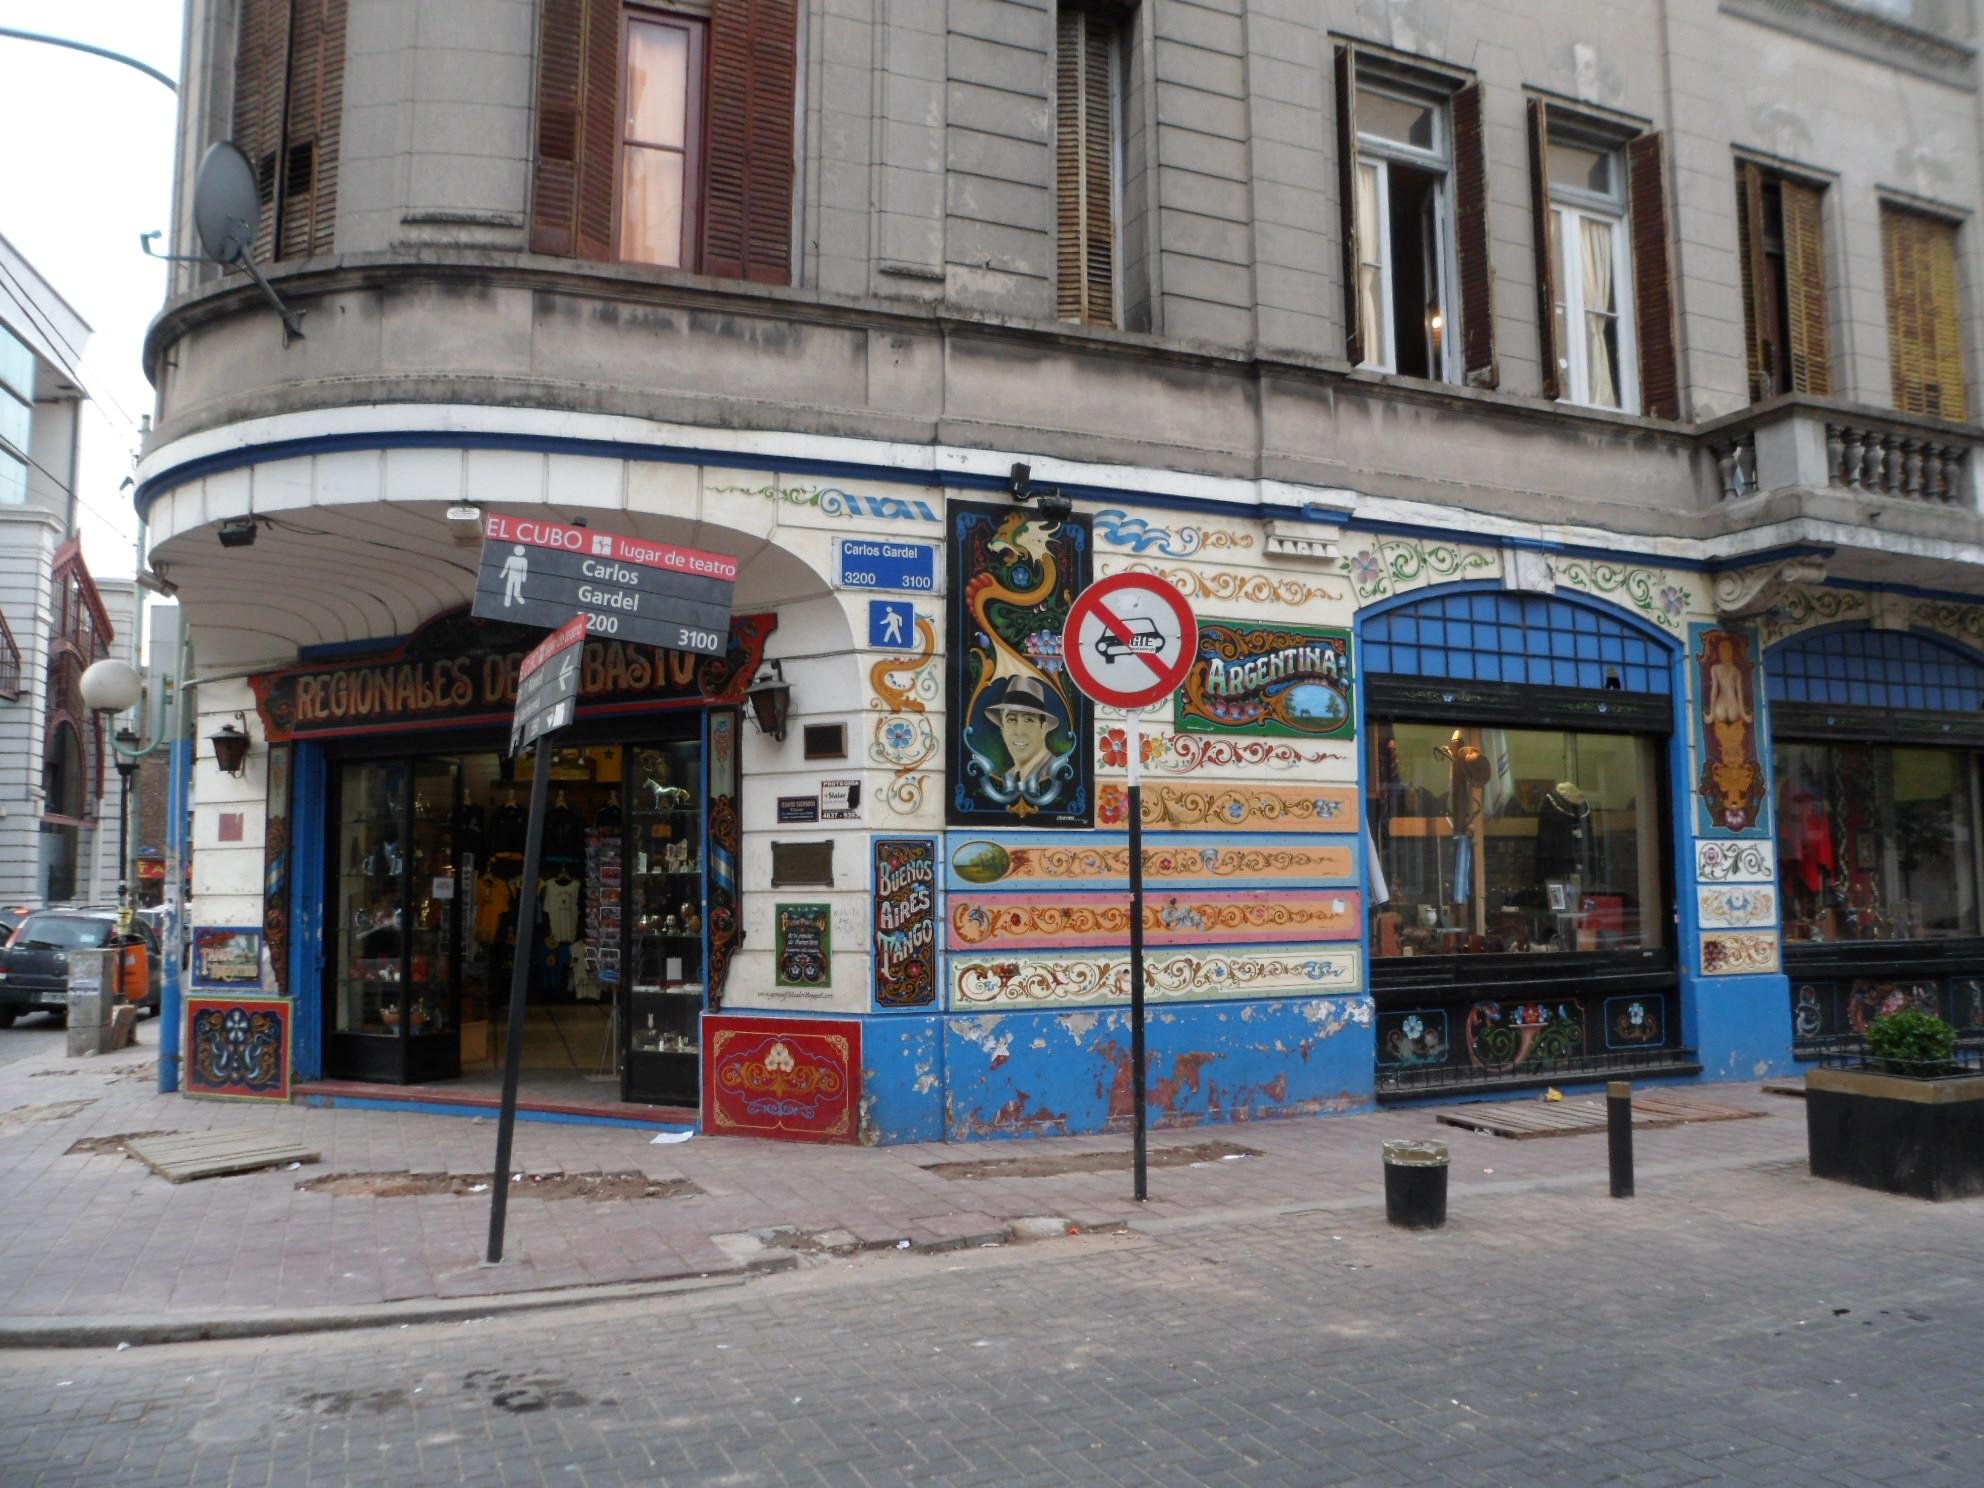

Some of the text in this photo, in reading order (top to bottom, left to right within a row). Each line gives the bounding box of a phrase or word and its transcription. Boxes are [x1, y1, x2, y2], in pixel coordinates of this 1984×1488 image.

[486, 518, 736, 577] EL CUBO lugar de teatro
[843, 542, 918, 559] Carlos Gardel
[582, 560, 639, 585] Carlos
[844, 571, 931, 589] 3200 3100
[578, 585, 639, 612] Gardel
[577, 611, 718, 650] 200 3100
[297, 658, 474, 719] REGIONALES
[1206, 647, 1338, 696] ARGENTINA
[880, 860, 933, 897] BUENOS
[880, 890, 930, 929] AIRES
[877, 919, 934, 981] TANGO
